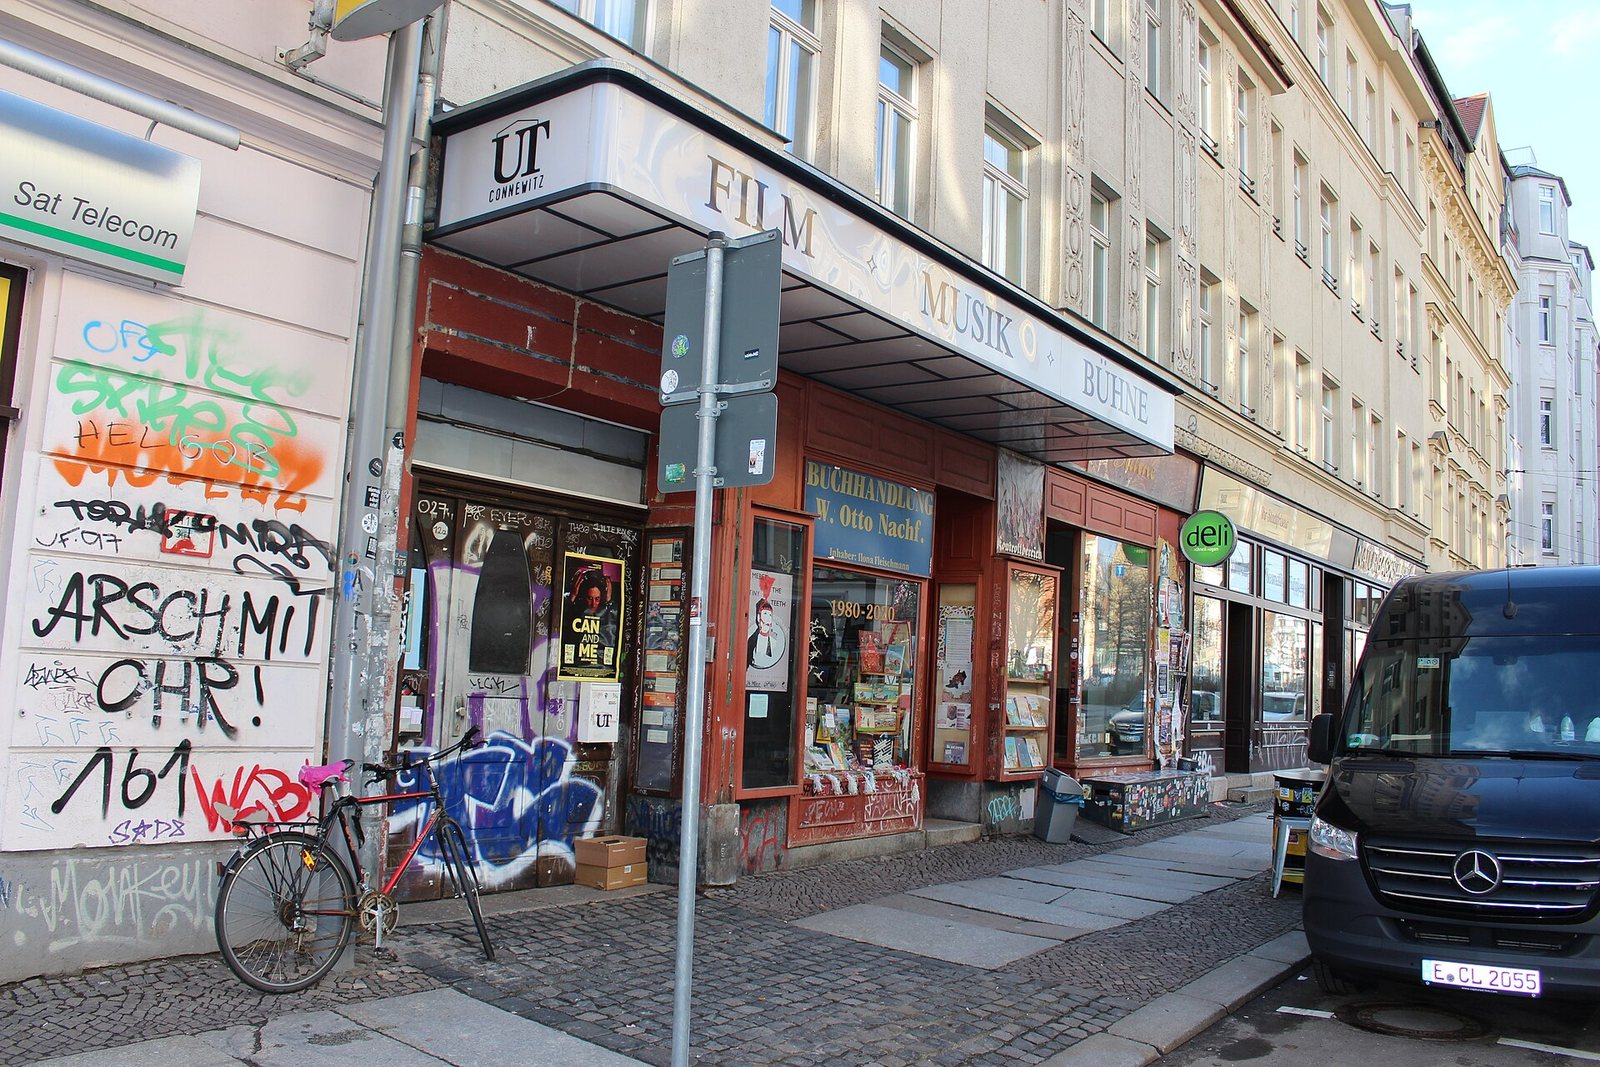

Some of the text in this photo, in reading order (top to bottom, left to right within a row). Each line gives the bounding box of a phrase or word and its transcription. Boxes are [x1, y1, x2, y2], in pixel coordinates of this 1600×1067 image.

[492, 119, 550, 185] UT
[488, 174, 545, 203] CONNEWITZ
[14, 181, 179, 250] Sat Telecom
[705, 155, 818, 259] FILM
[920, 270, 1014, 359] MUSIK
[1081, 358, 1150, 425] BÜHNE
[807, 461, 934, 516] BUCHHANDLUNG
[816, 498, 925, 544] W. Otto Nachf.
[1187, 523, 1229, 547] deli
[828, 546, 910, 571] Inhaber: Ilona Fleischmann
[771, 599, 787, 608] TEETH
[772, 586, 782, 595] THE
[33, 571, 320, 661] ARSCH MIT
[572, 617, 600, 634] CAN
[578, 644, 599, 659] ME
[581, 634, 600, 644] AND
[596, 713, 612, 728] UT
[51, 738, 193, 820] 161
[1434, 963, 1537, 990] E CL 2055
